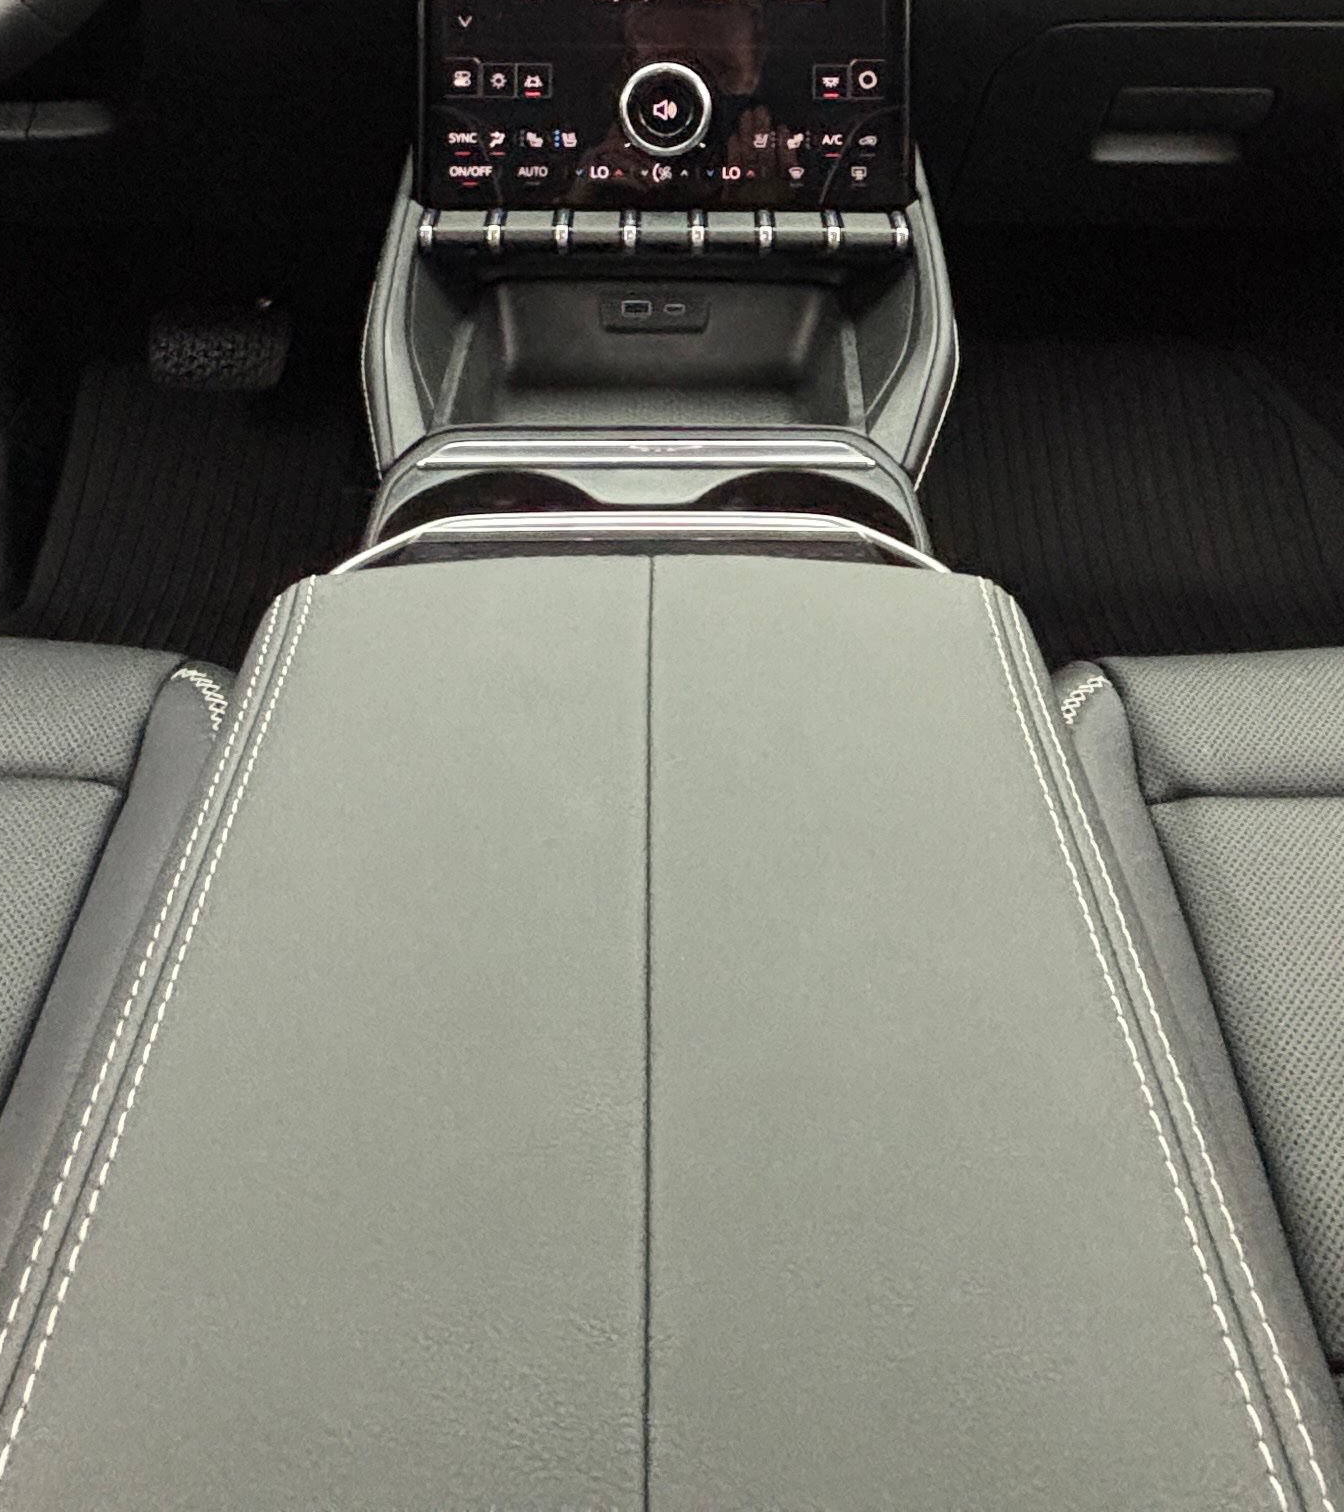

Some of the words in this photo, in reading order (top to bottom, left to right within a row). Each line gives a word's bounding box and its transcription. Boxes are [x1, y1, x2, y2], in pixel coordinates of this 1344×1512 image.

[448, 132, 478, 144] SYNC
[821, 133, 844, 146] A/C
[448, 165, 493, 178] ON/OFF
[517, 165, 549, 178] AUTO
[590, 165, 610, 180] LO
[721, 165, 742, 180] LO
